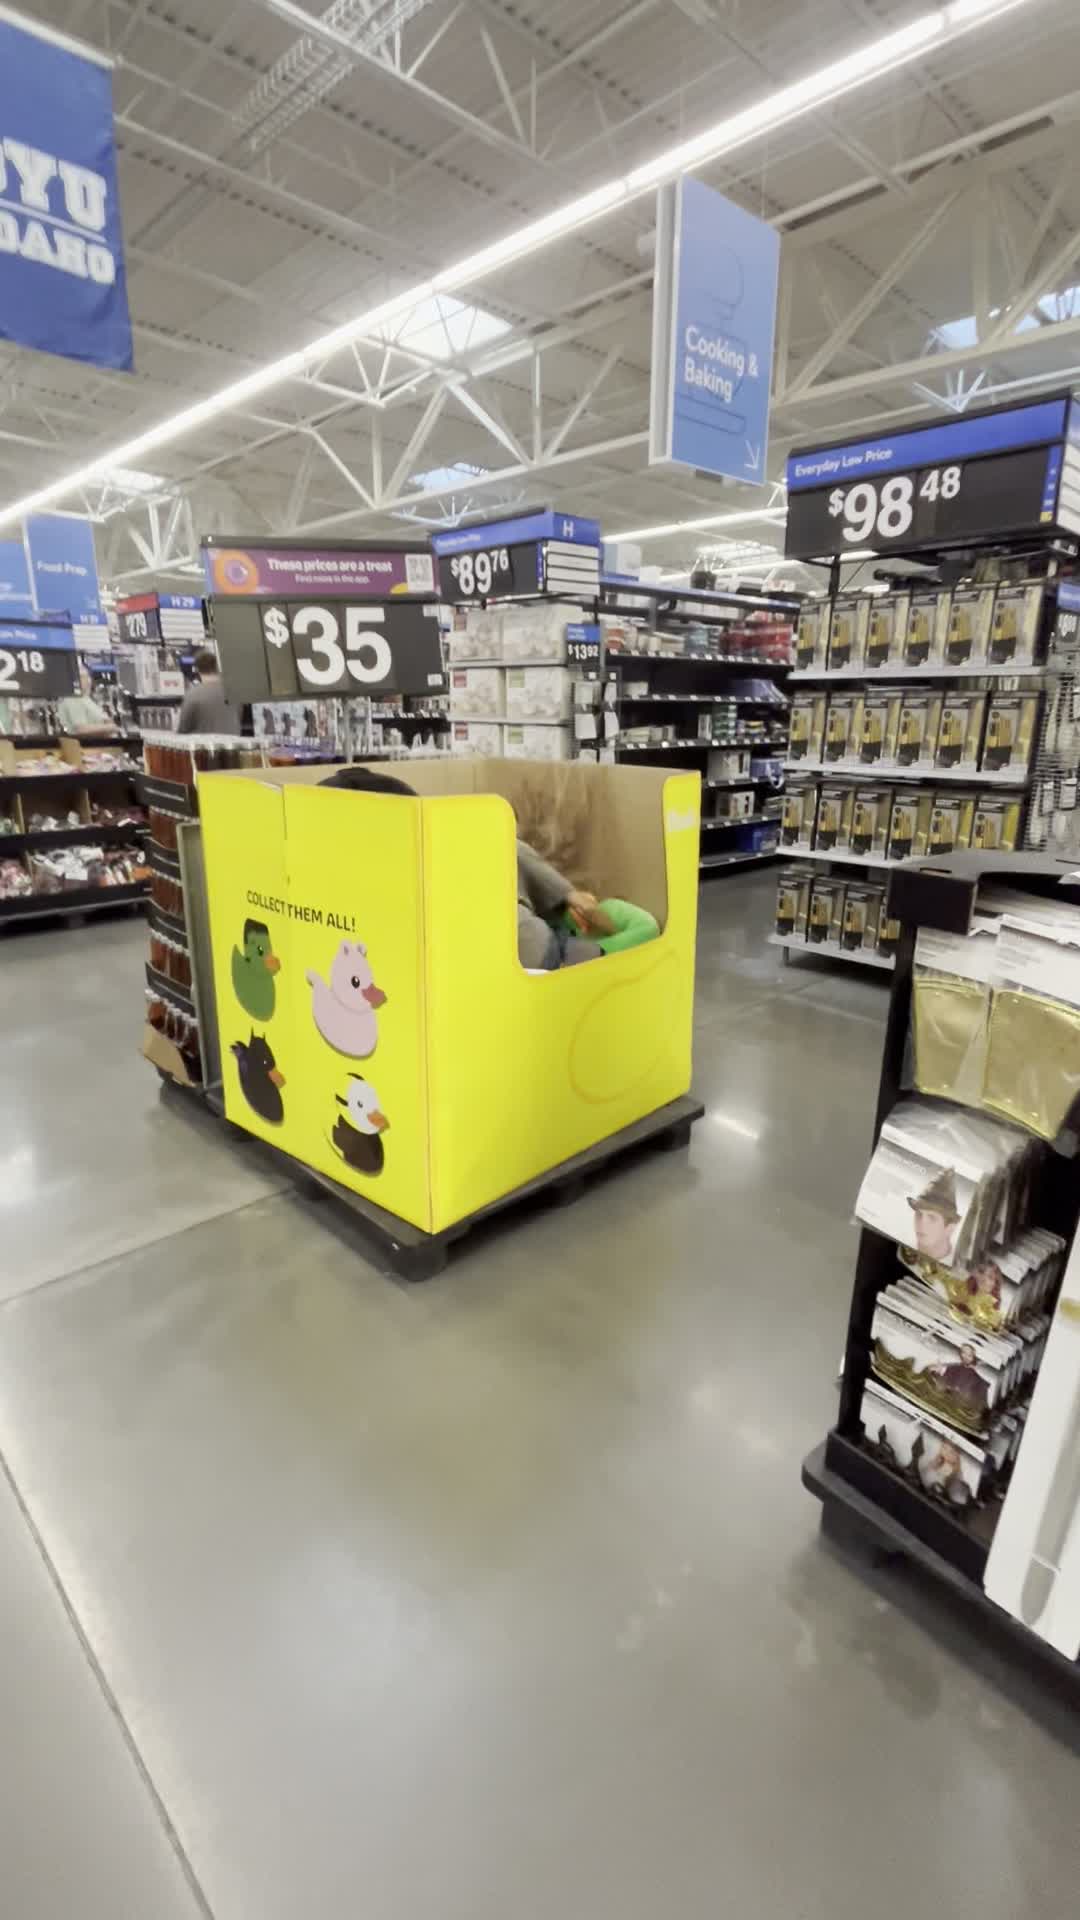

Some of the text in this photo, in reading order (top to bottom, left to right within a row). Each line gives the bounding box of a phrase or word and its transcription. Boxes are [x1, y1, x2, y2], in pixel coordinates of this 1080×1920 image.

[0, 136, 107, 232] YU
[685, 325, 759, 377] Cooking &
[684, 356, 732, 403] Baking
[795, 459, 840, 477] Everyday
[865, 449, 893, 462] Price
[562, 520, 574, 537] H
[267, 558, 302, 571] These
[304, 558, 338, 573] prices
[340, 560, 357, 572] are
[366, 560, 393, 573] treat
[263, 606, 392, 686] $35
[247, 890, 356, 933] COLLECT THEM ALL!
